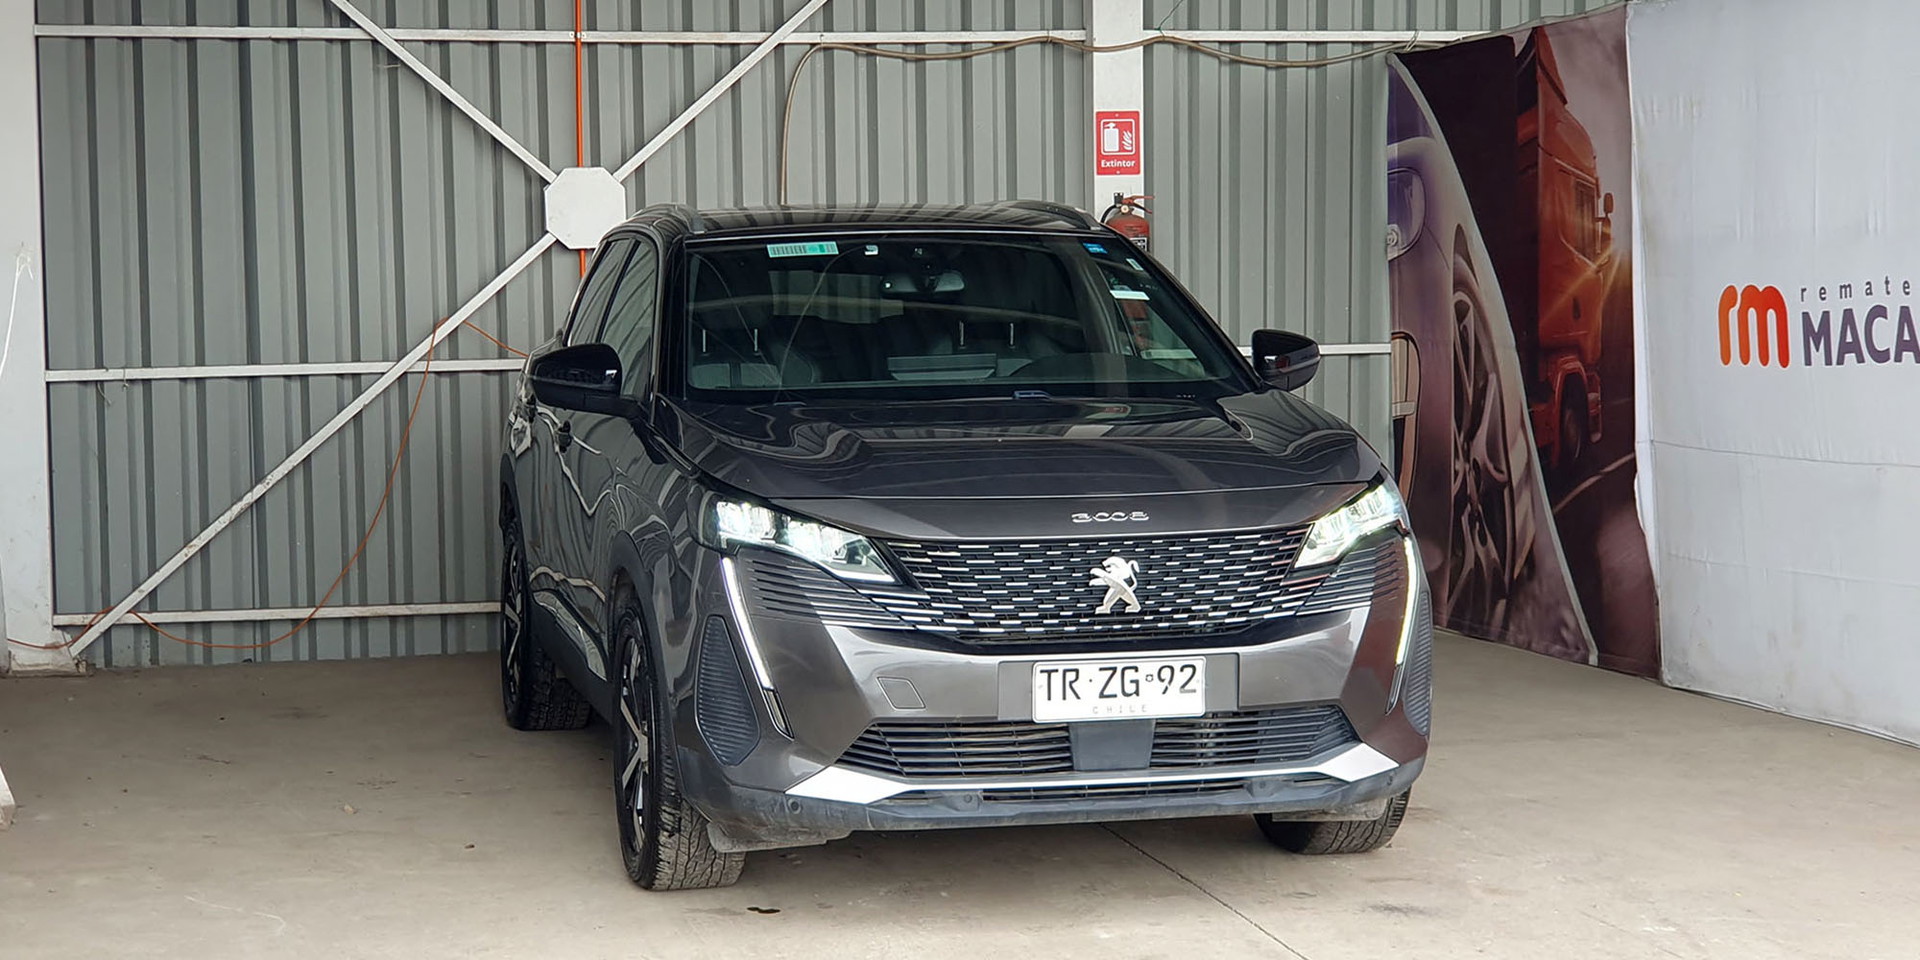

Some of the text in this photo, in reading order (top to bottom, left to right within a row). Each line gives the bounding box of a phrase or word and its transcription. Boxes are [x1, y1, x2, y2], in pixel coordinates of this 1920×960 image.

[1101, 159, 1136, 168] Extintor
[1800, 276, 1911, 302] remate
[1718, 284, 1790, 369] rm
[1801, 304, 1920, 367] MACA
[1092, 704, 1148, 714] CHILE
